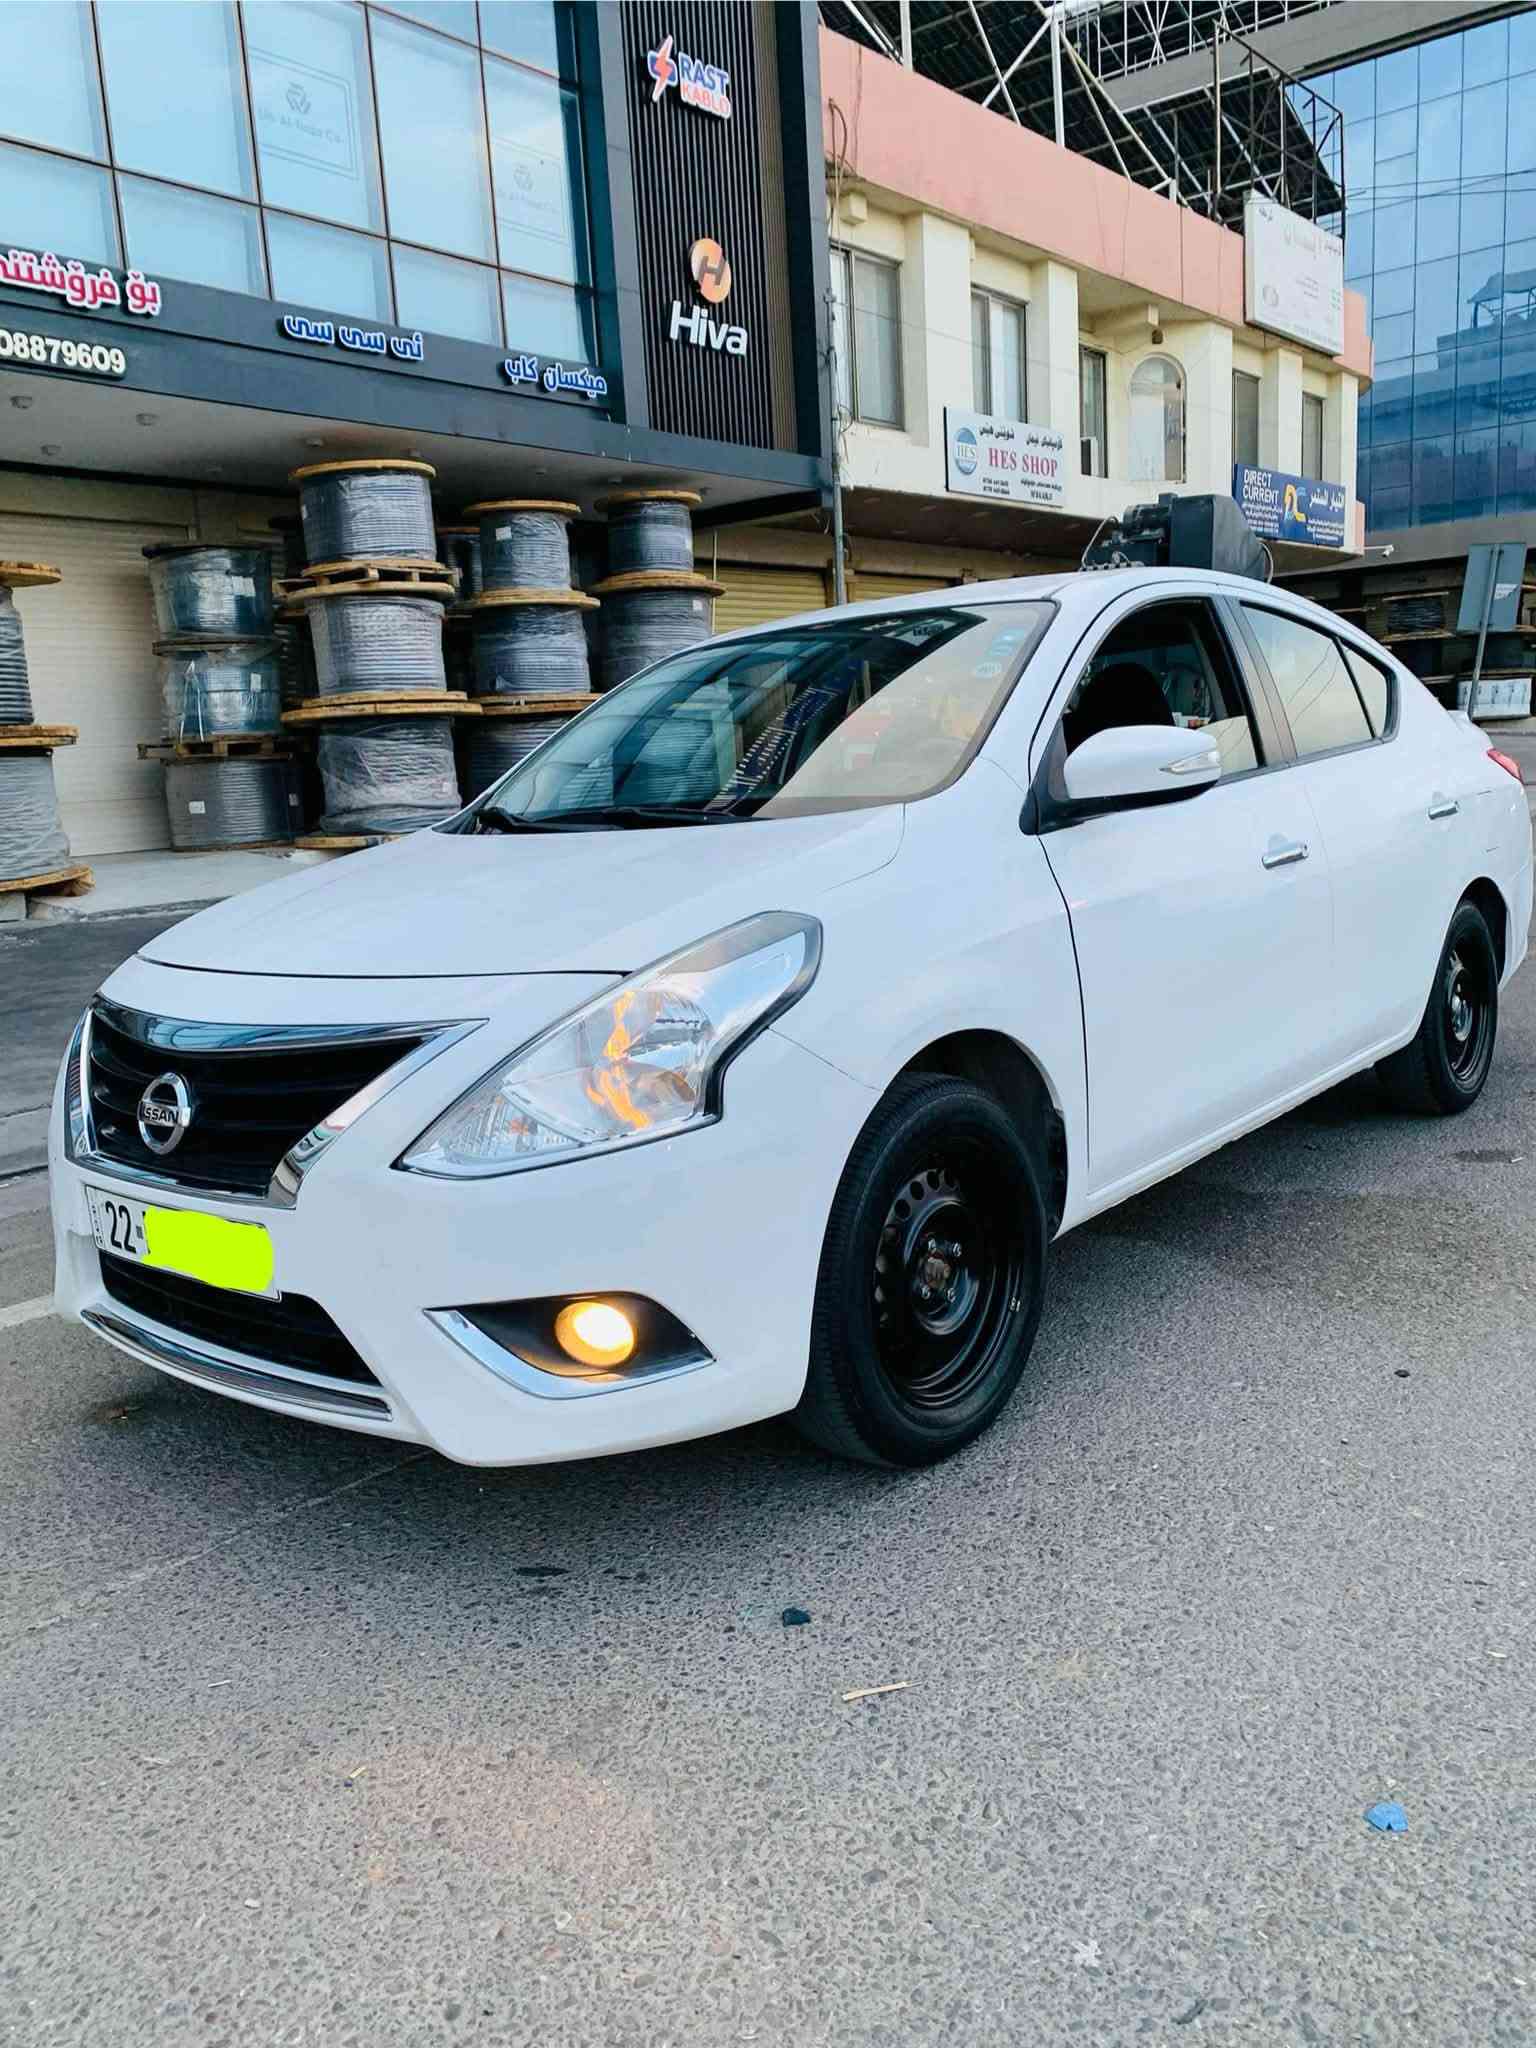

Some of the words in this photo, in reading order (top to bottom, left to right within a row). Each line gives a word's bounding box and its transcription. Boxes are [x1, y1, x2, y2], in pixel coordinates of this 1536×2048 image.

[679, 52, 729, 96] RAST
[127, 271, 160, 315] بۆ
[669, 300, 748, 355] Hiva
[0, 329, 126, 374] 08879609
[988, 447, 1017, 471] HES
[1022, 453, 1058, 478] SHOP
[1243, 469, 1272, 487] DIRECT
[1242, 485, 1280, 505] CURRENT
[141, 1106, 179, 1125] ISSAN
[105, 1200, 137, 1255] 22
